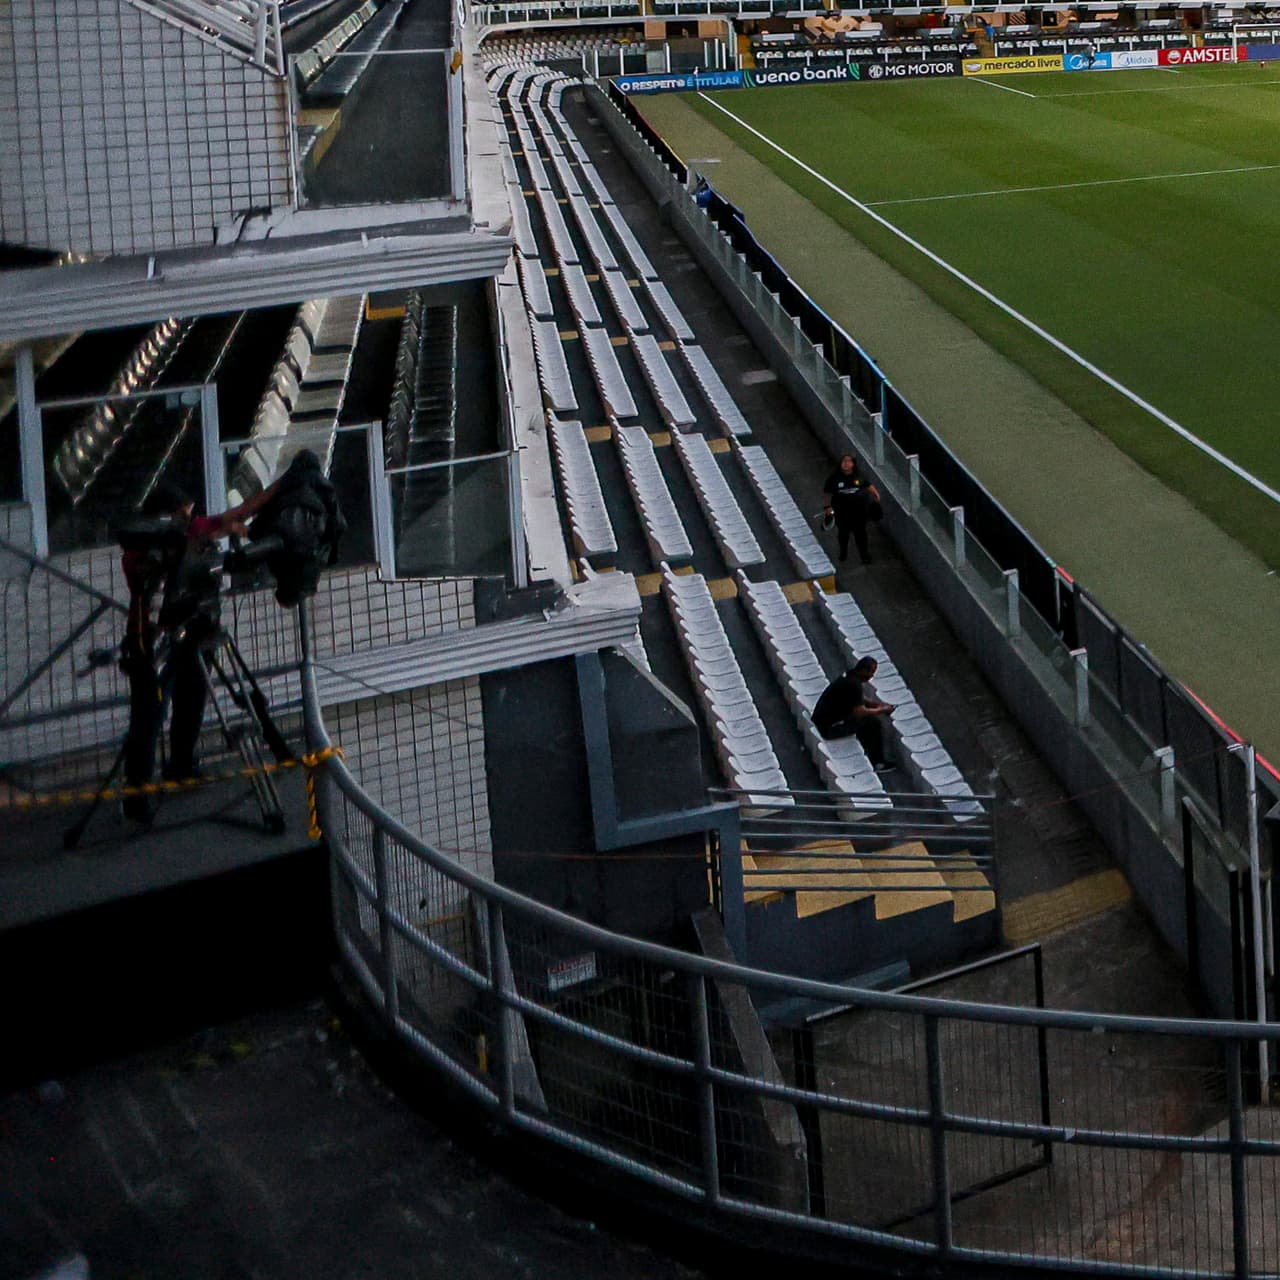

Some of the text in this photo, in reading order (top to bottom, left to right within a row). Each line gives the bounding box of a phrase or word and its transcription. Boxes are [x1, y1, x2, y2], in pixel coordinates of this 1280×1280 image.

[1182, 48, 1237, 63] AMSTEL
[885, 66, 905, 76] MG
[908, 63, 954, 75] MOTOR
[985, 60, 1036, 70] mercado
[1037, 59, 1061, 68] livre
[756, 66, 847, 84] ueno bank
[620, 83, 630, 91] O
[686, 77, 693, 88] É
[695, 76, 739, 86] TITULAR
